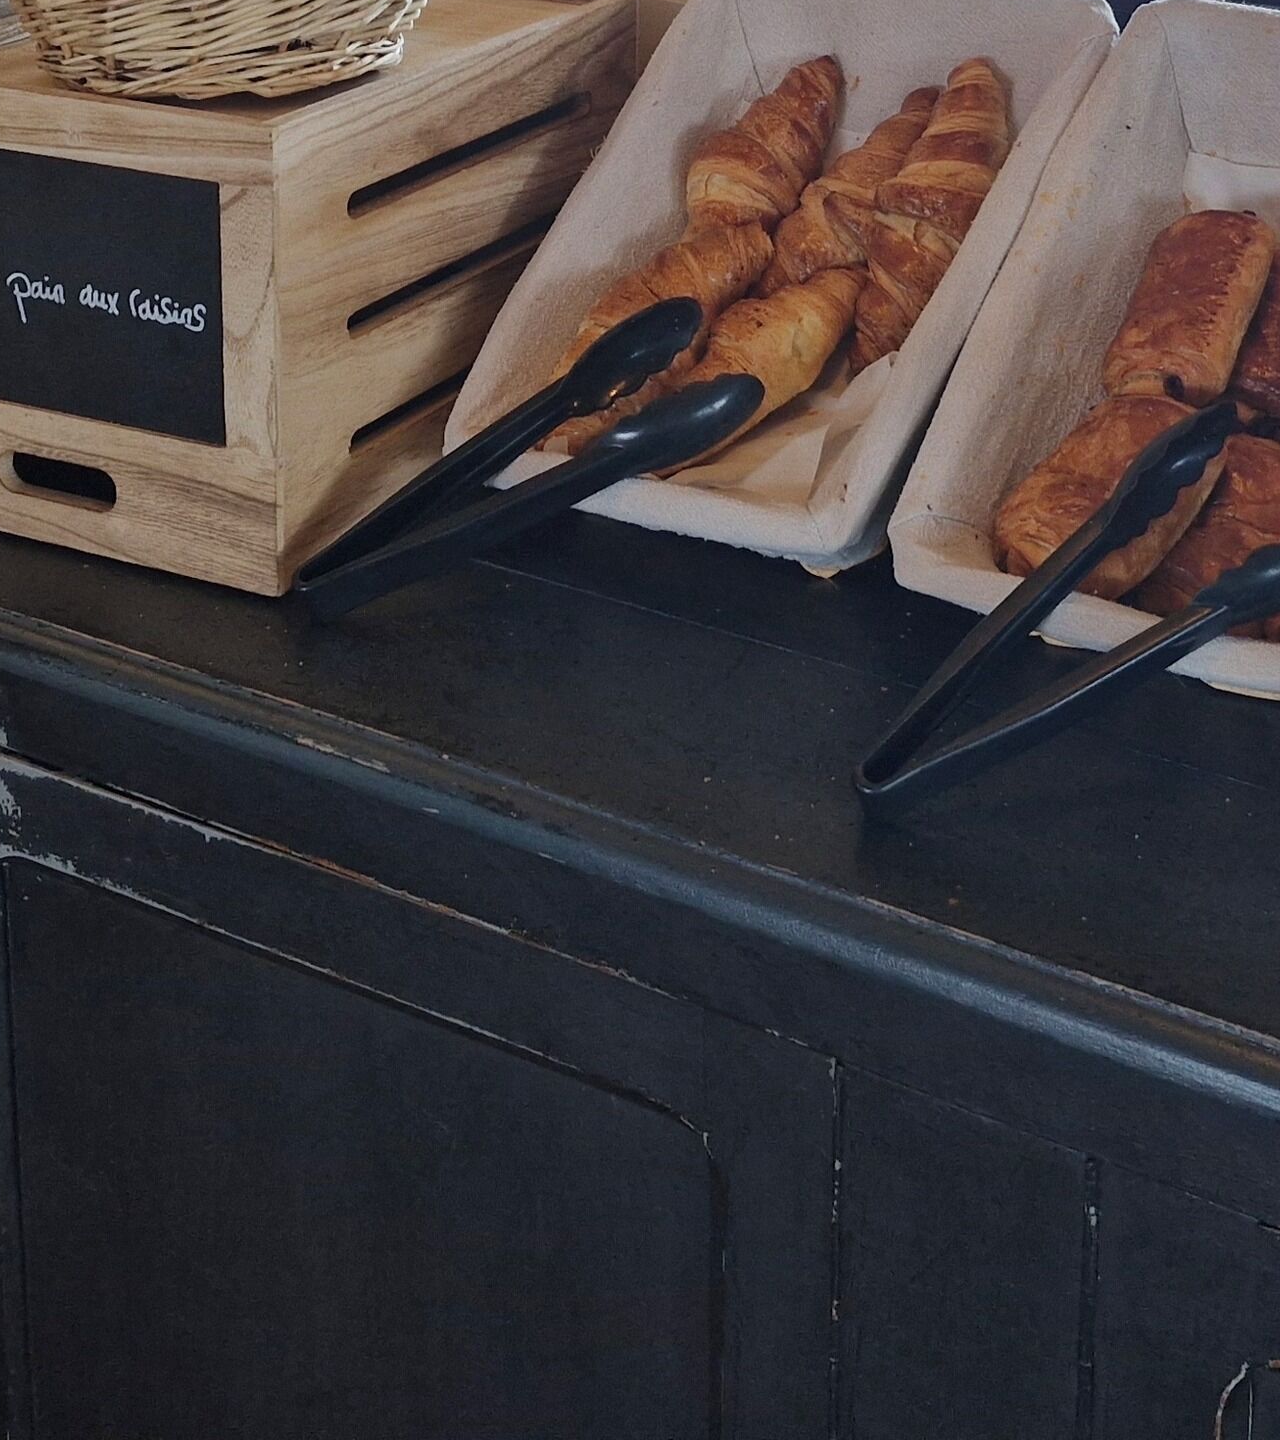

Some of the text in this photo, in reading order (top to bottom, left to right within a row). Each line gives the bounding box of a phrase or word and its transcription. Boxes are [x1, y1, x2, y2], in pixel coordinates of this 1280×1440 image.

[6, 272, 66, 324] pain
[78, 283, 120, 316] aux
[128, 288, 207, 332] raisins
